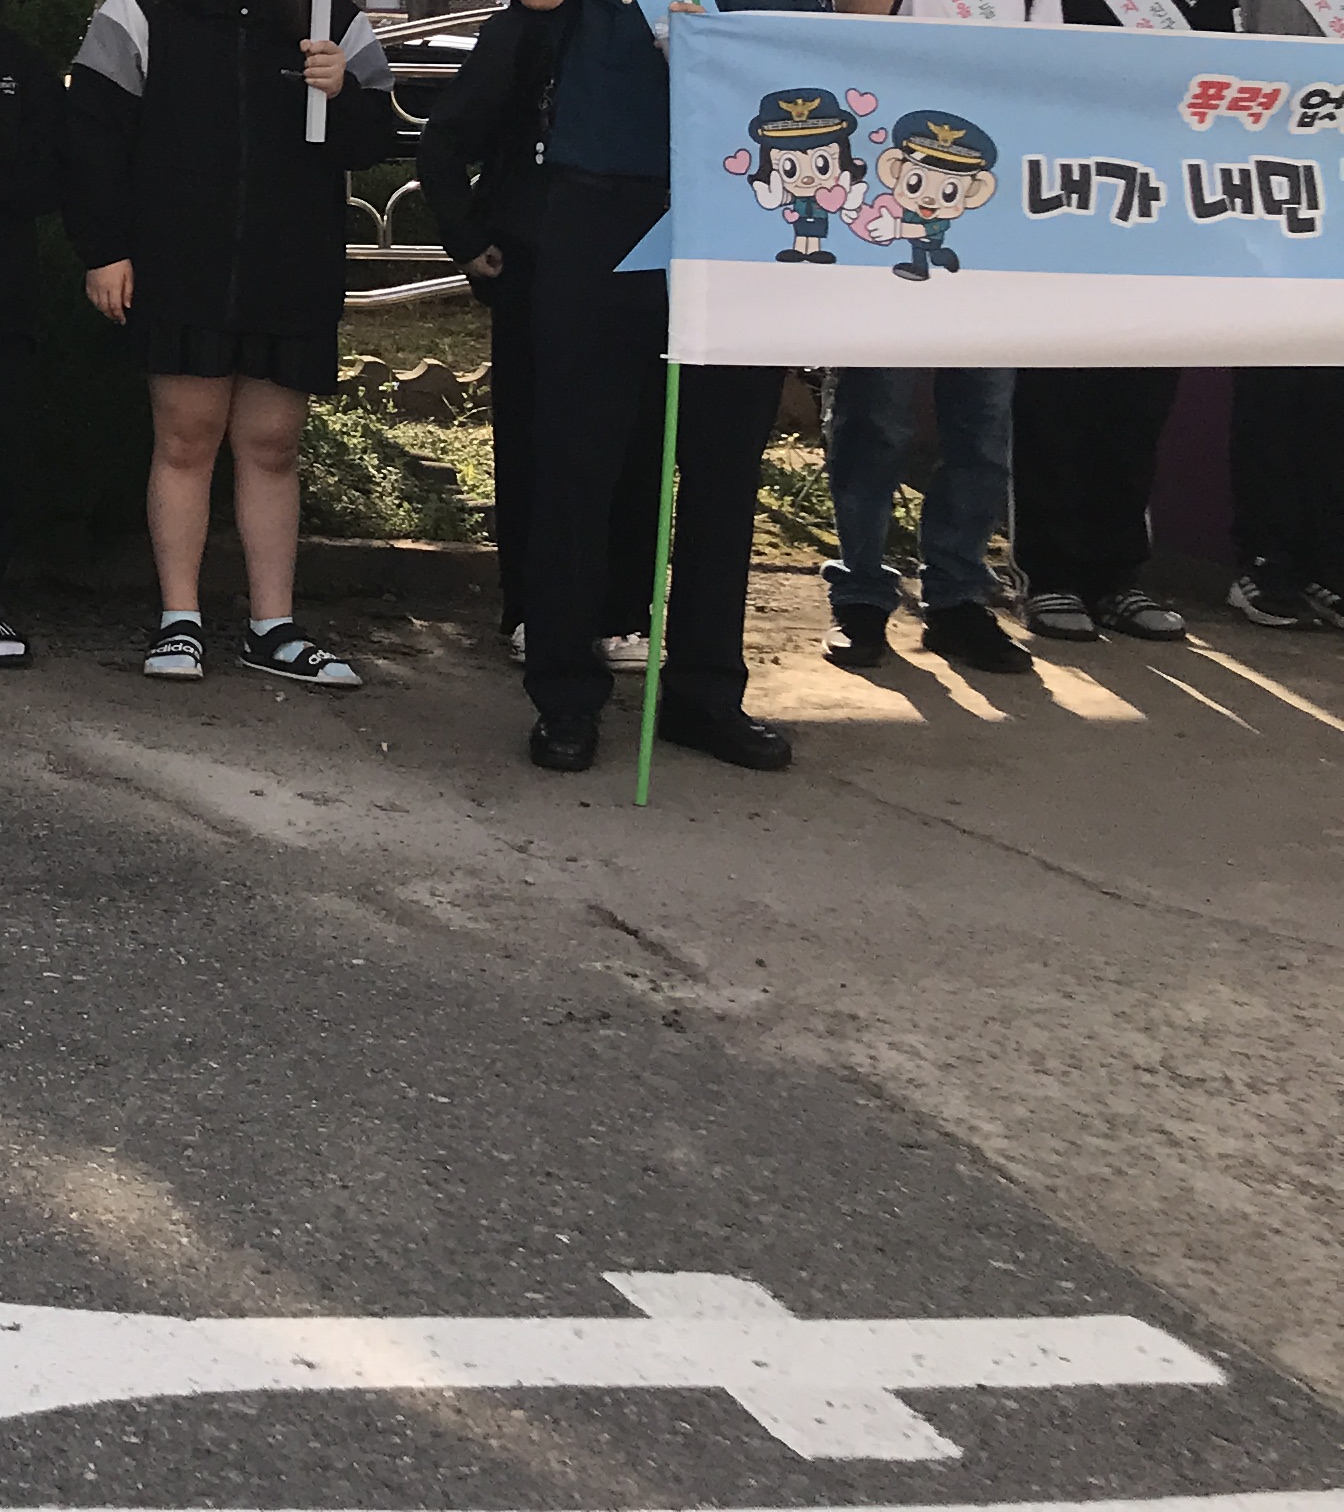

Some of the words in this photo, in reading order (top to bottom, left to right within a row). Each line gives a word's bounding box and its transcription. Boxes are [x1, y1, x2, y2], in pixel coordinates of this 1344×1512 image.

[1185, 78, 1284, 126] 폭력
[1296, 87, 1344, 129] 없
[1025, 157, 1162, 223] 내가
[1185, 157, 1321, 234] 내민
